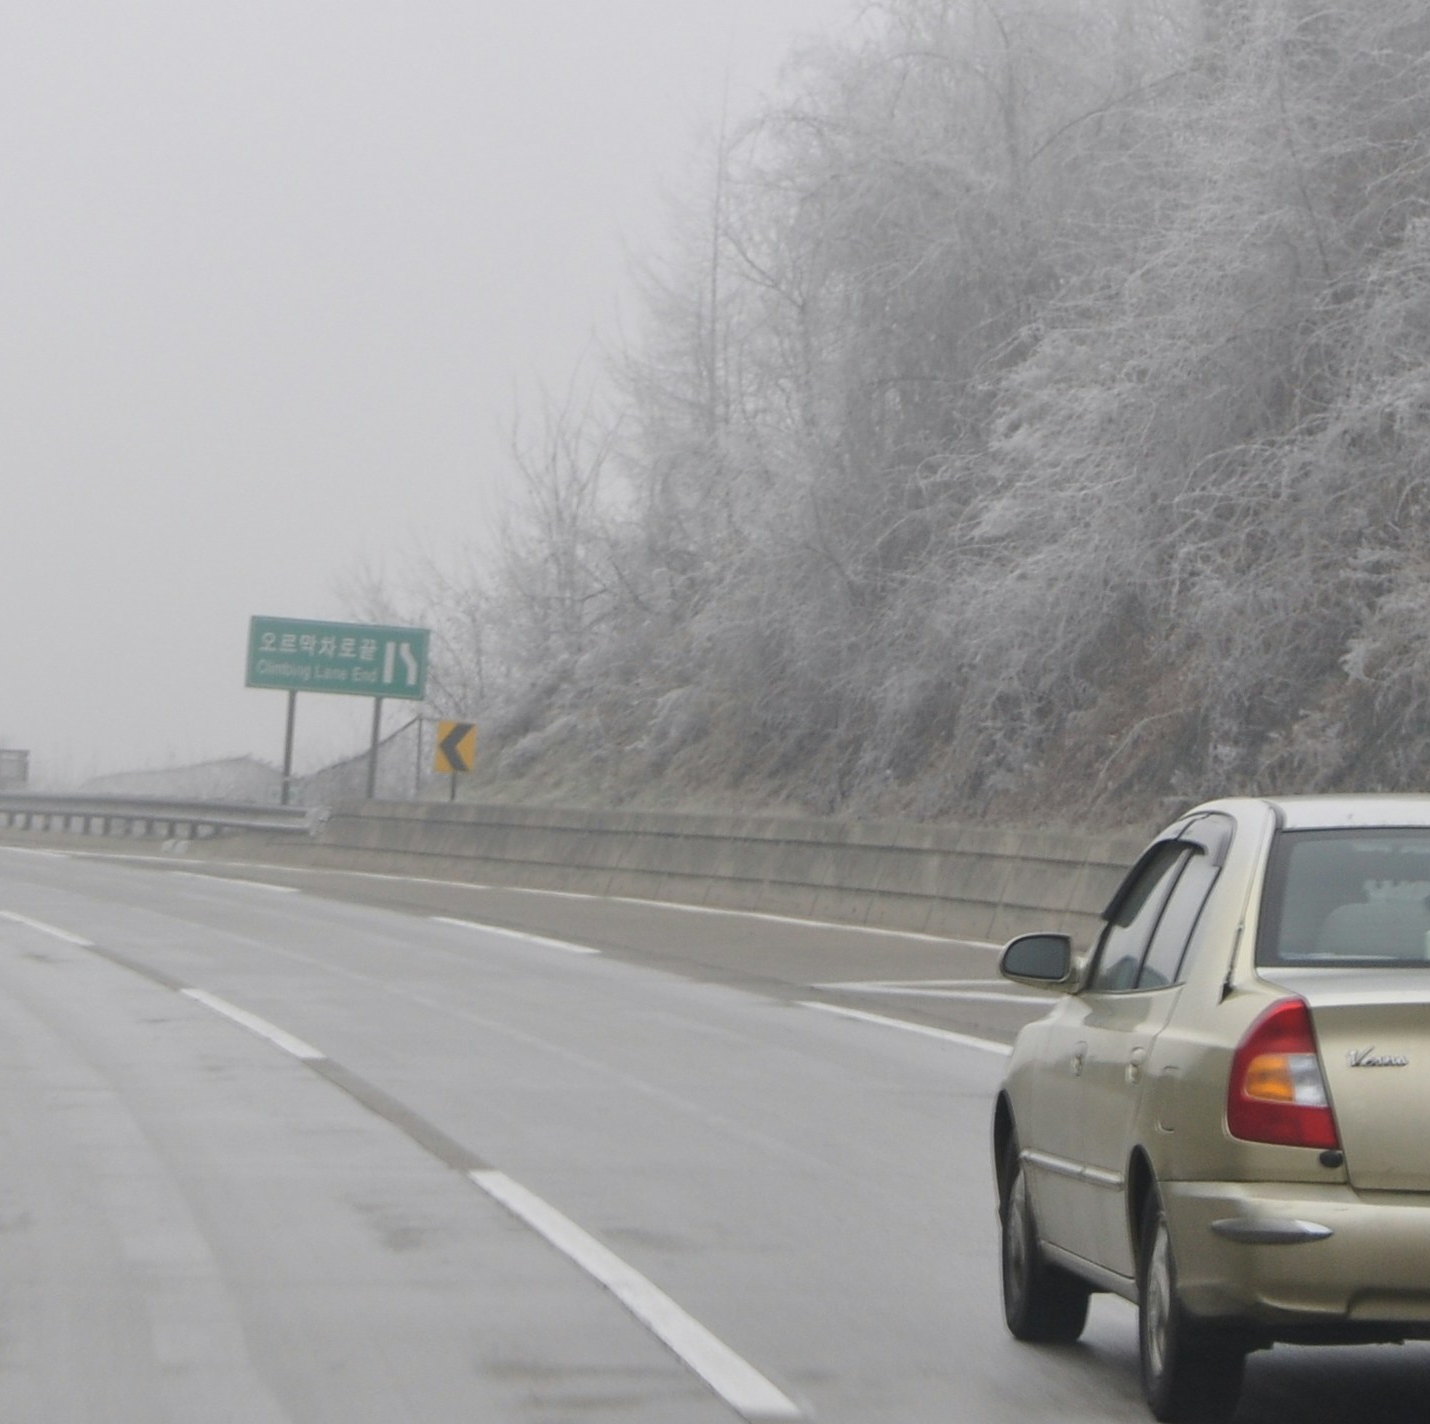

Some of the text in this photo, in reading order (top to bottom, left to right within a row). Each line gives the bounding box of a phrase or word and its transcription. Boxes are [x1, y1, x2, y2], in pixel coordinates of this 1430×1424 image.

[255, 659, 379, 684] Climbing Lane End
